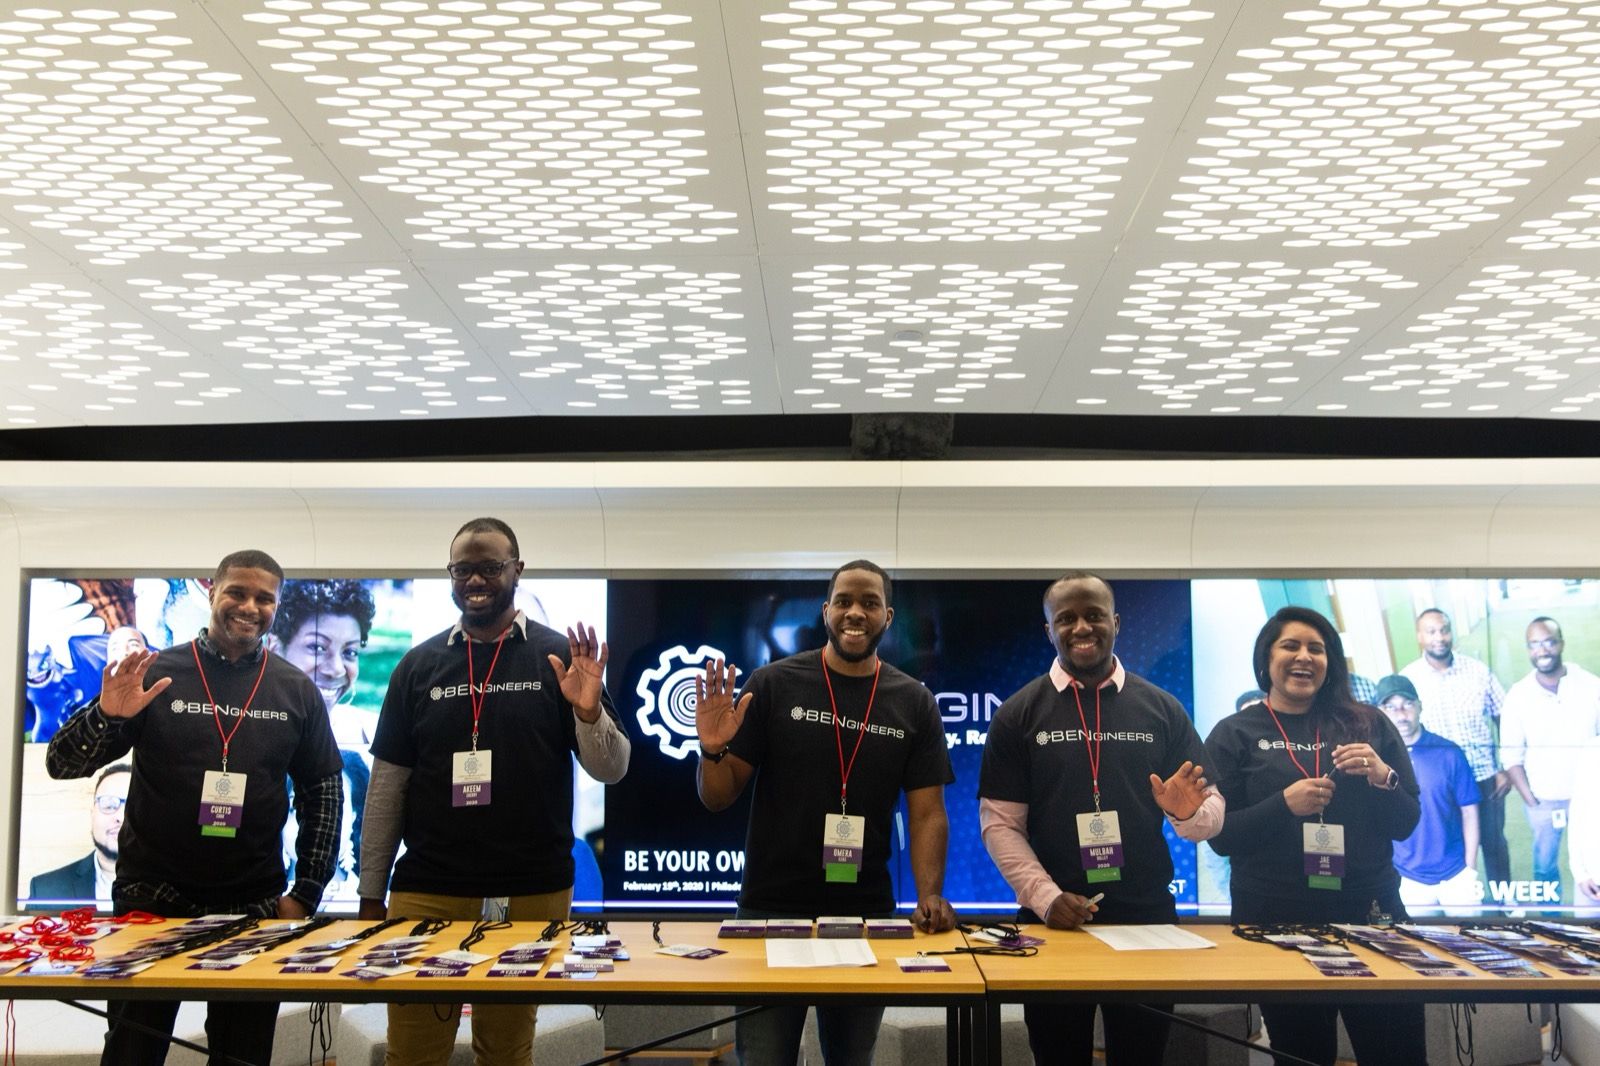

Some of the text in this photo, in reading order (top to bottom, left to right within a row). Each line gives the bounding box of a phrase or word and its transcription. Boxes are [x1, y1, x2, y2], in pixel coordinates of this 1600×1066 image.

[444, 681, 542, 699] BENGINEERS
[187, 702, 288, 721] BENGINEERS
[805, 709, 905, 739] BENGINEERS
[1051, 729, 1154, 743] BENGINEERS
[463, 784, 482, 794] AKEEM
[210, 805, 232, 815] CURTIS
[624, 849, 649, 872] BE
[653, 849, 711, 873] YOUR
[833, 848, 853, 858] OMERA
[623, 881, 662, 893] February
[682, 881, 705, 892] 2020
[1488, 880, 1561, 902] WEEK
